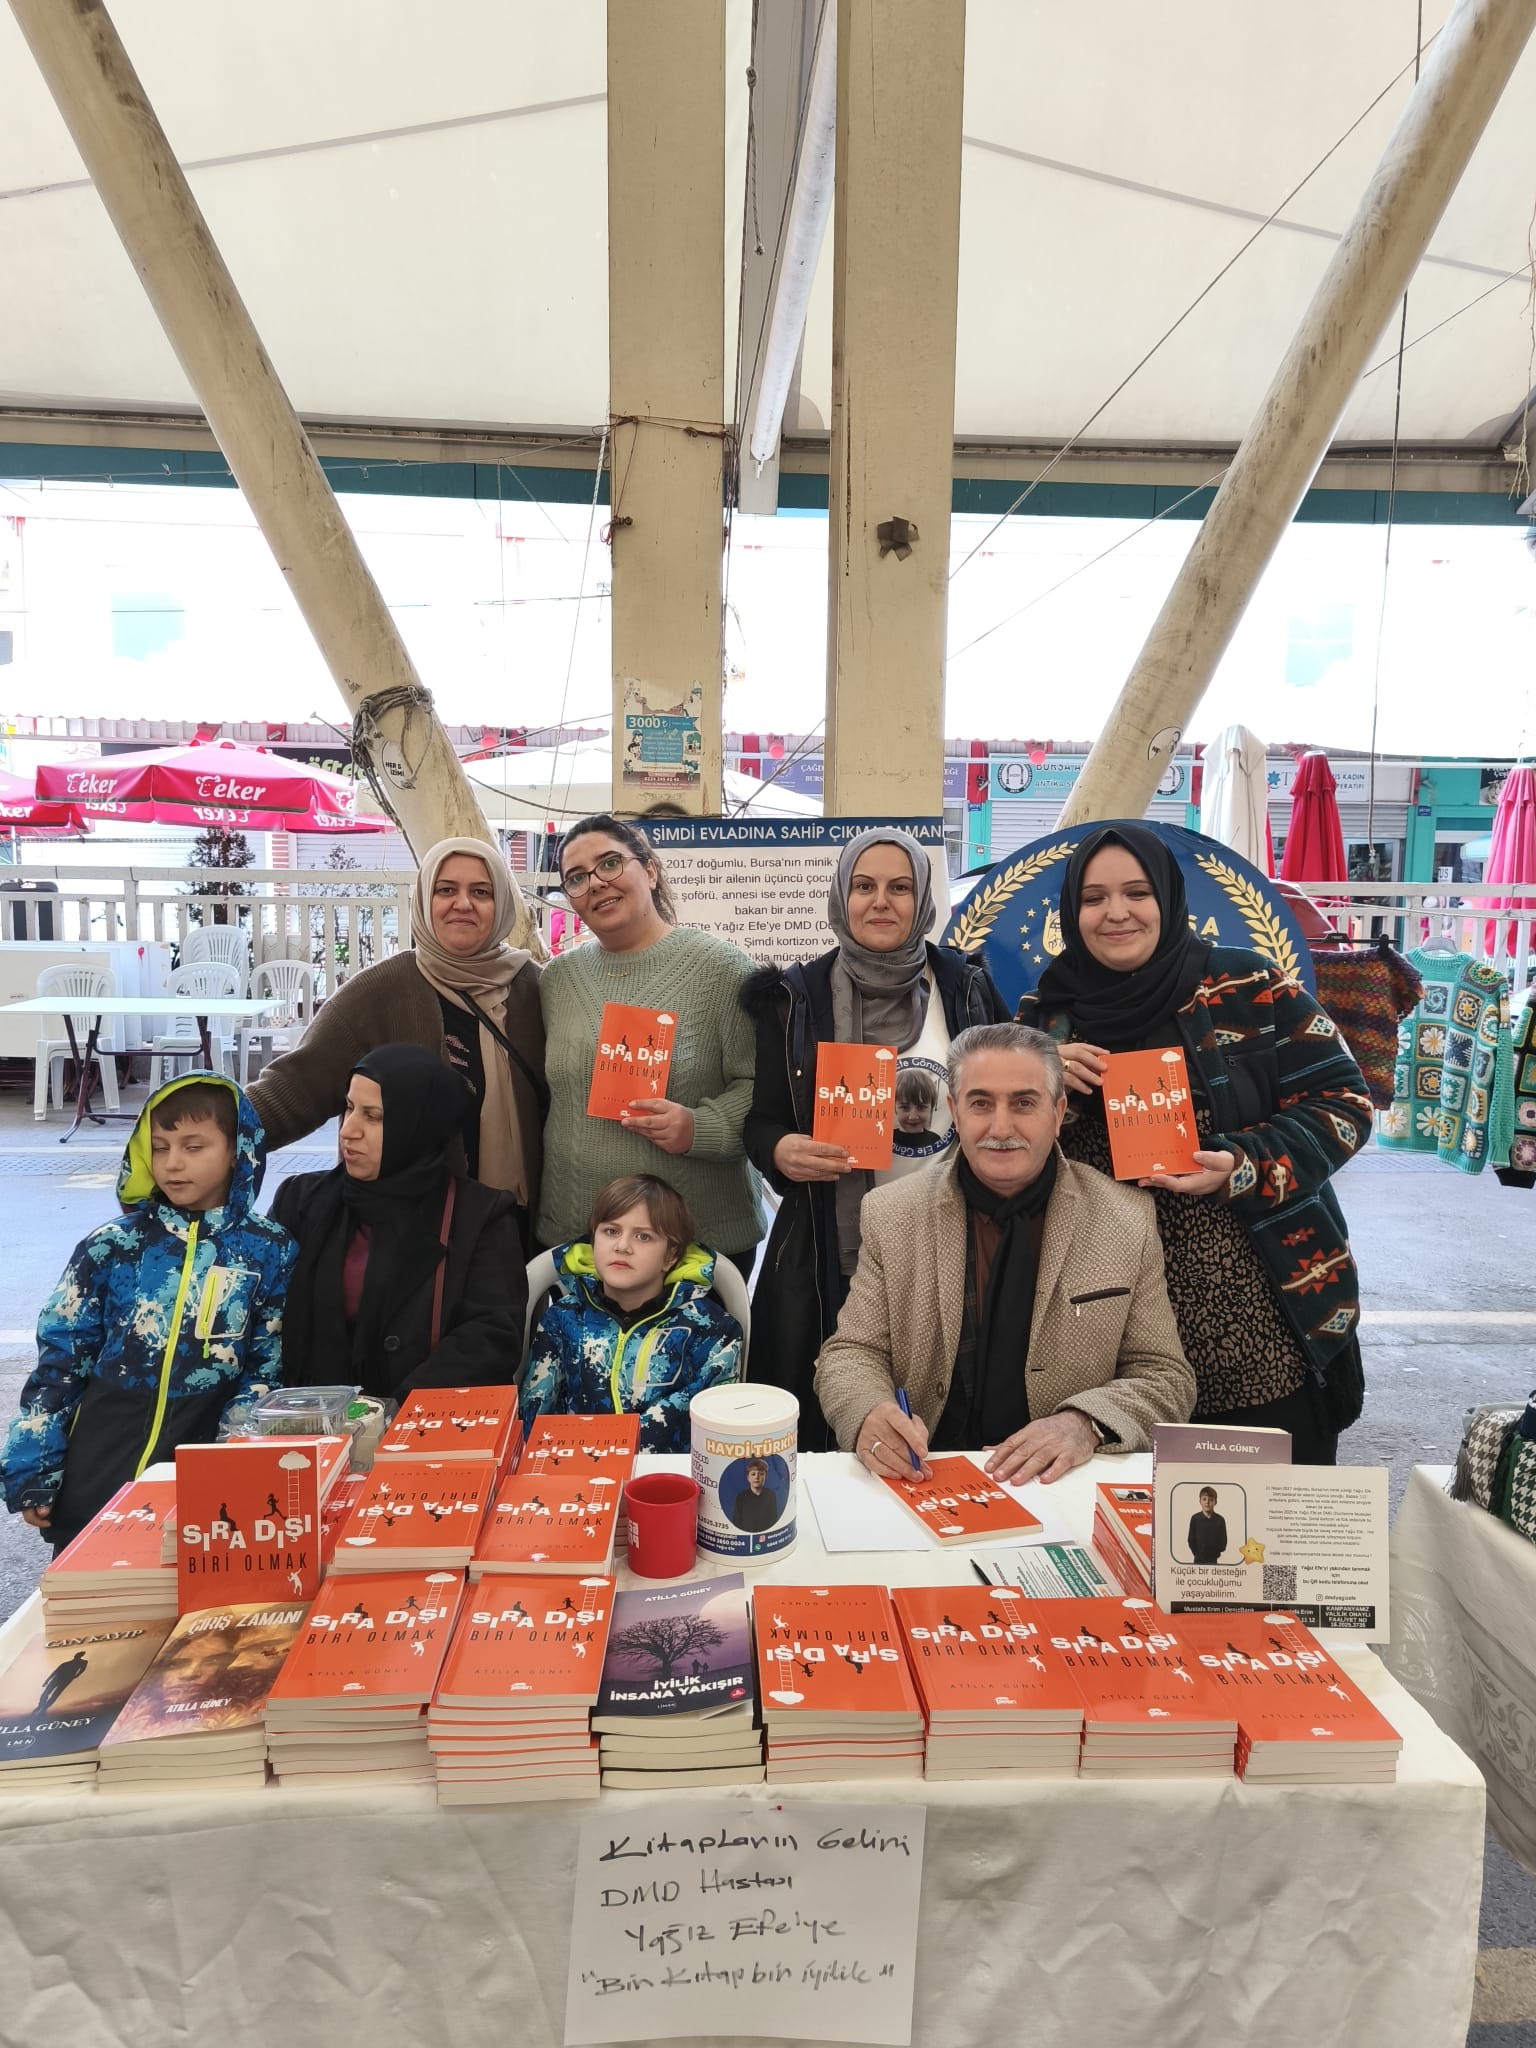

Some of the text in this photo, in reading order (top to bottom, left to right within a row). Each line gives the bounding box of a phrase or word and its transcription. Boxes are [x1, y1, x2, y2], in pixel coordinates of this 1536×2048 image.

[652, 824, 695, 844] ŞİMDİ
[701, 826, 776, 840] EVLADINA
[781, 823, 825, 839] SAHİP
[666, 859, 693, 869] 2017
[697, 858, 746, 871] doğumlu,
[805, 857, 833, 867] minik
[709, 875, 722, 884] bir
[726, 874, 761, 884] ailenin
[764, 873, 803, 885] üçüncü
[722, 890, 758, 899] annesi
[761, 890, 776, 899] ise
[779, 889, 806, 899] evde
[808, 888, 829, 898] dört
[735, 905, 817, 915] bakan bir anne.
[714, 922, 745, 933] Yağız
[748, 921, 781, 934] Efe'ye
[784, 920, 811, 930] DMD
[744, 936, 774, 948] Şimdi
[777, 936, 819, 946] kortizon
[600, 1043, 668, 1067] SIRA DIŞI
[818, 1085, 892, 1107] SIRA DIŞI
[1108, 1088, 1188, 1115] SIRA DIŞI
[706, 1438, 751, 1458] HAYDİ
[1195, 1441, 1260, 1454] ATİLLA GÜNEY
[496, 1502, 551, 1516] SIRA
[182, 1514, 312, 1552] SIRA DIŞI
[188, 1552, 307, 1574] BİRİ OLMAK
[1170, 1566, 1247, 1578] Küçük bir desteğin
[1175, 1577, 1242, 1588] ile çocukluğumu
[236, 1610, 303, 1628] ZAMANI
[310, 1606, 448, 1631] SIRA DIŞI
[471, 1609, 605, 1629] SIRA DIŞI
[367, 1629, 436, 1643] OLMAK
[529, 1630, 595, 1642] OLMAK
[910, 1622, 1039, 1644] SIRA DIŞI
[978, 1644, 1044, 1656] OLMAK
[1050, 1633, 1178, 1655] SIRA DIŞI
[832, 1643, 899, 1663] SIRA
[1198, 1650, 1328, 1672] SIRA DIŞI
[1120, 1656, 1188, 1668] OLMAK
[654, 1675, 701, 1690] İYİLİK
[1272, 1672, 1342, 1685] OLMAK
[610, 1676, 744, 1701] İNSANA YAKIŞIR
[36, 1716, 96, 1732] GÜNEY
[600, 1880, 680, 1907] DMD
